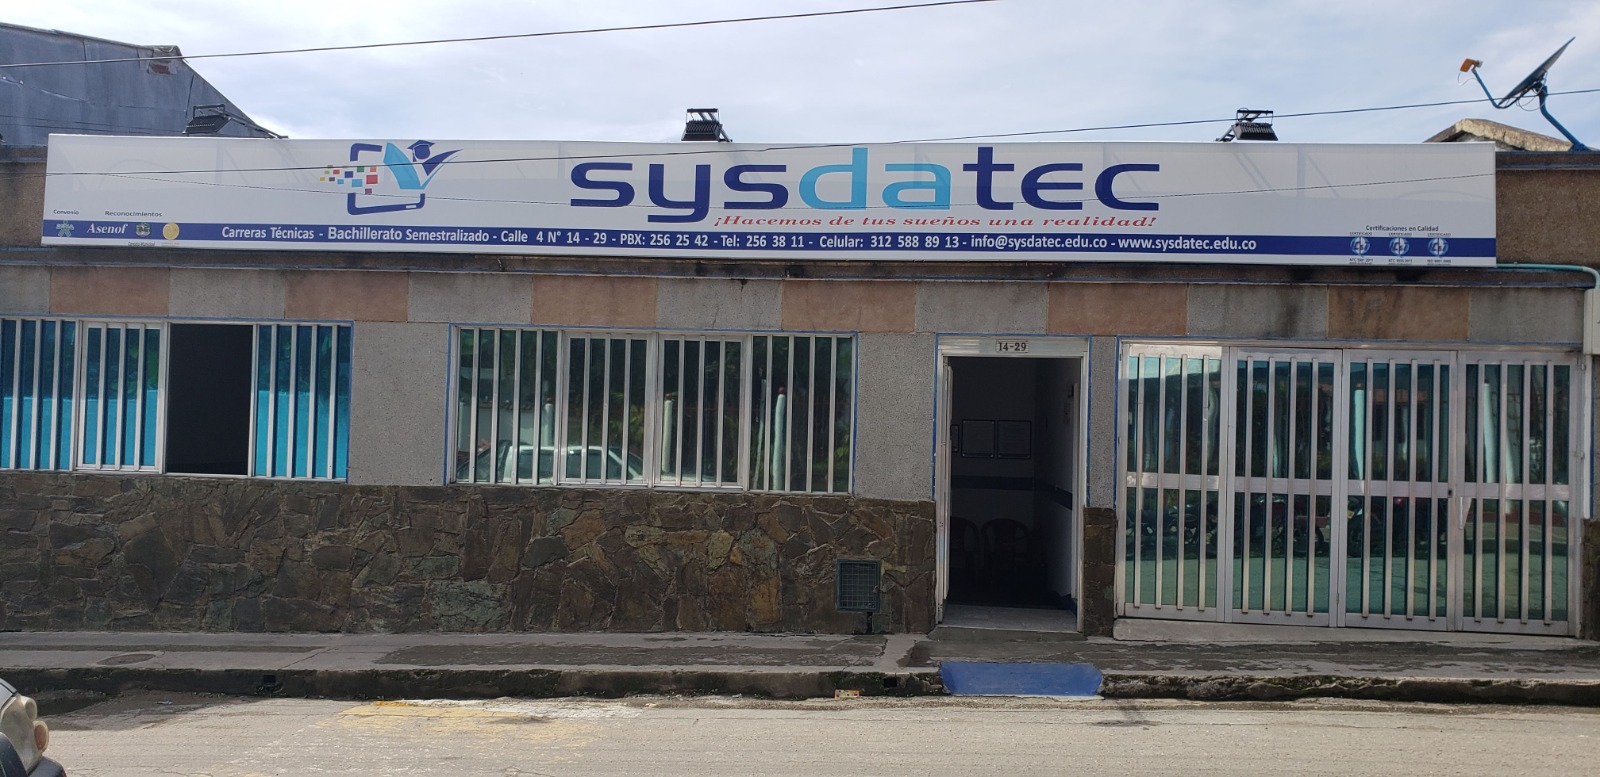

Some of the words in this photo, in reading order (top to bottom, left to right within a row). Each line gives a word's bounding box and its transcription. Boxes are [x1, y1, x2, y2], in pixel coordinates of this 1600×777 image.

[570, 146, 1160, 223] sysdatec
[53, 208, 79, 216] Convenio
[104, 210, 163, 218] Reconocimientos
[714, 216, 822, 227] ¡Hacemos
[828, 216, 855, 226] de
[862, 216, 896, 226] tus
[902, 217, 981, 226] sueños
[988, 219, 1034, 227] una
[1042, 216, 1157, 228] realidad!
[86, 223, 129, 235] Asenof
[221, 226, 267, 239] Carreras
[270, 226, 315, 240] Técnicas
[328, 226, 403, 241] Bachillerato
[405, 228, 490, 242] Semestralizado
[500, 230, 528, 243] Calle
[536, 231, 544, 243] 4
[566, 231, 580, 244] 14
[593, 232, 607, 244] 29
[620, 233, 646, 246] PBX:
[649, 233, 671, 246] 256
[675, 234, 690, 247] 25
[694, 234, 709, 247] 42
[720, 234, 740, 248] Tel:
[746, 235, 767, 248] 256
[772, 235, 786, 248] 38
[791, 235, 804, 248] 11
[819, 235, 864, 248] Celular:
[870, 235, 892, 248] 312
[897, 235, 919, 248] 588
[924, 235, 940, 248] 89
[945, 235, 959, 248] 13
[970, 235, 1108, 250] info@sysdatec.edu.co
[1117, 237, 1257, 252] www.sysdatec.edu.co
[998, 342, 1027, 352] 14-29
